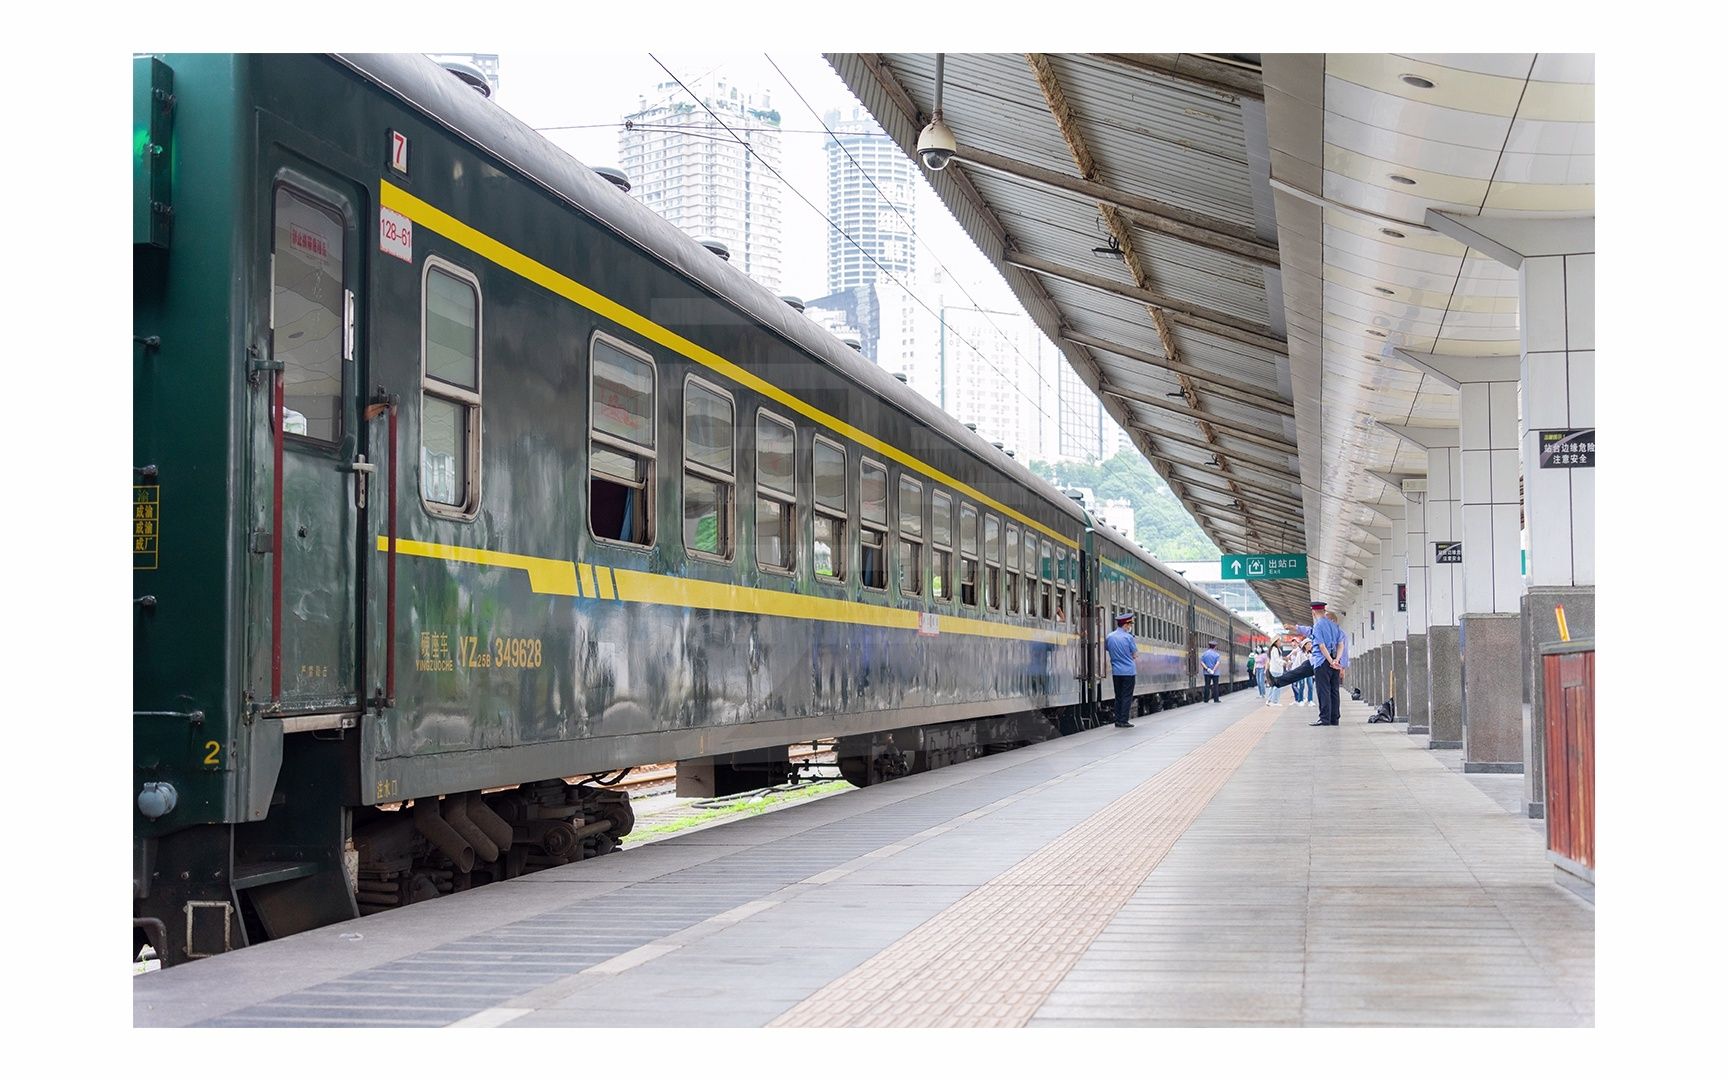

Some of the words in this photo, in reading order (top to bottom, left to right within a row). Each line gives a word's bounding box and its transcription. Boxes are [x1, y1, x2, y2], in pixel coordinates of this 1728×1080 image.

[394, 133, 404, 164] 7
[381, 219, 411, 248] 128-61
[1544, 442, 1595, 453] 站台边缘危险
[1553, 454, 1587, 464] 注意安全
[1268, 559, 1297, 569] 出站口
[420, 631, 448, 658] 硬座车
[495, 637, 542, 668] 349628
[416, 659, 453, 671] YINGZUOCHE
[204, 740, 220, 764] 2
